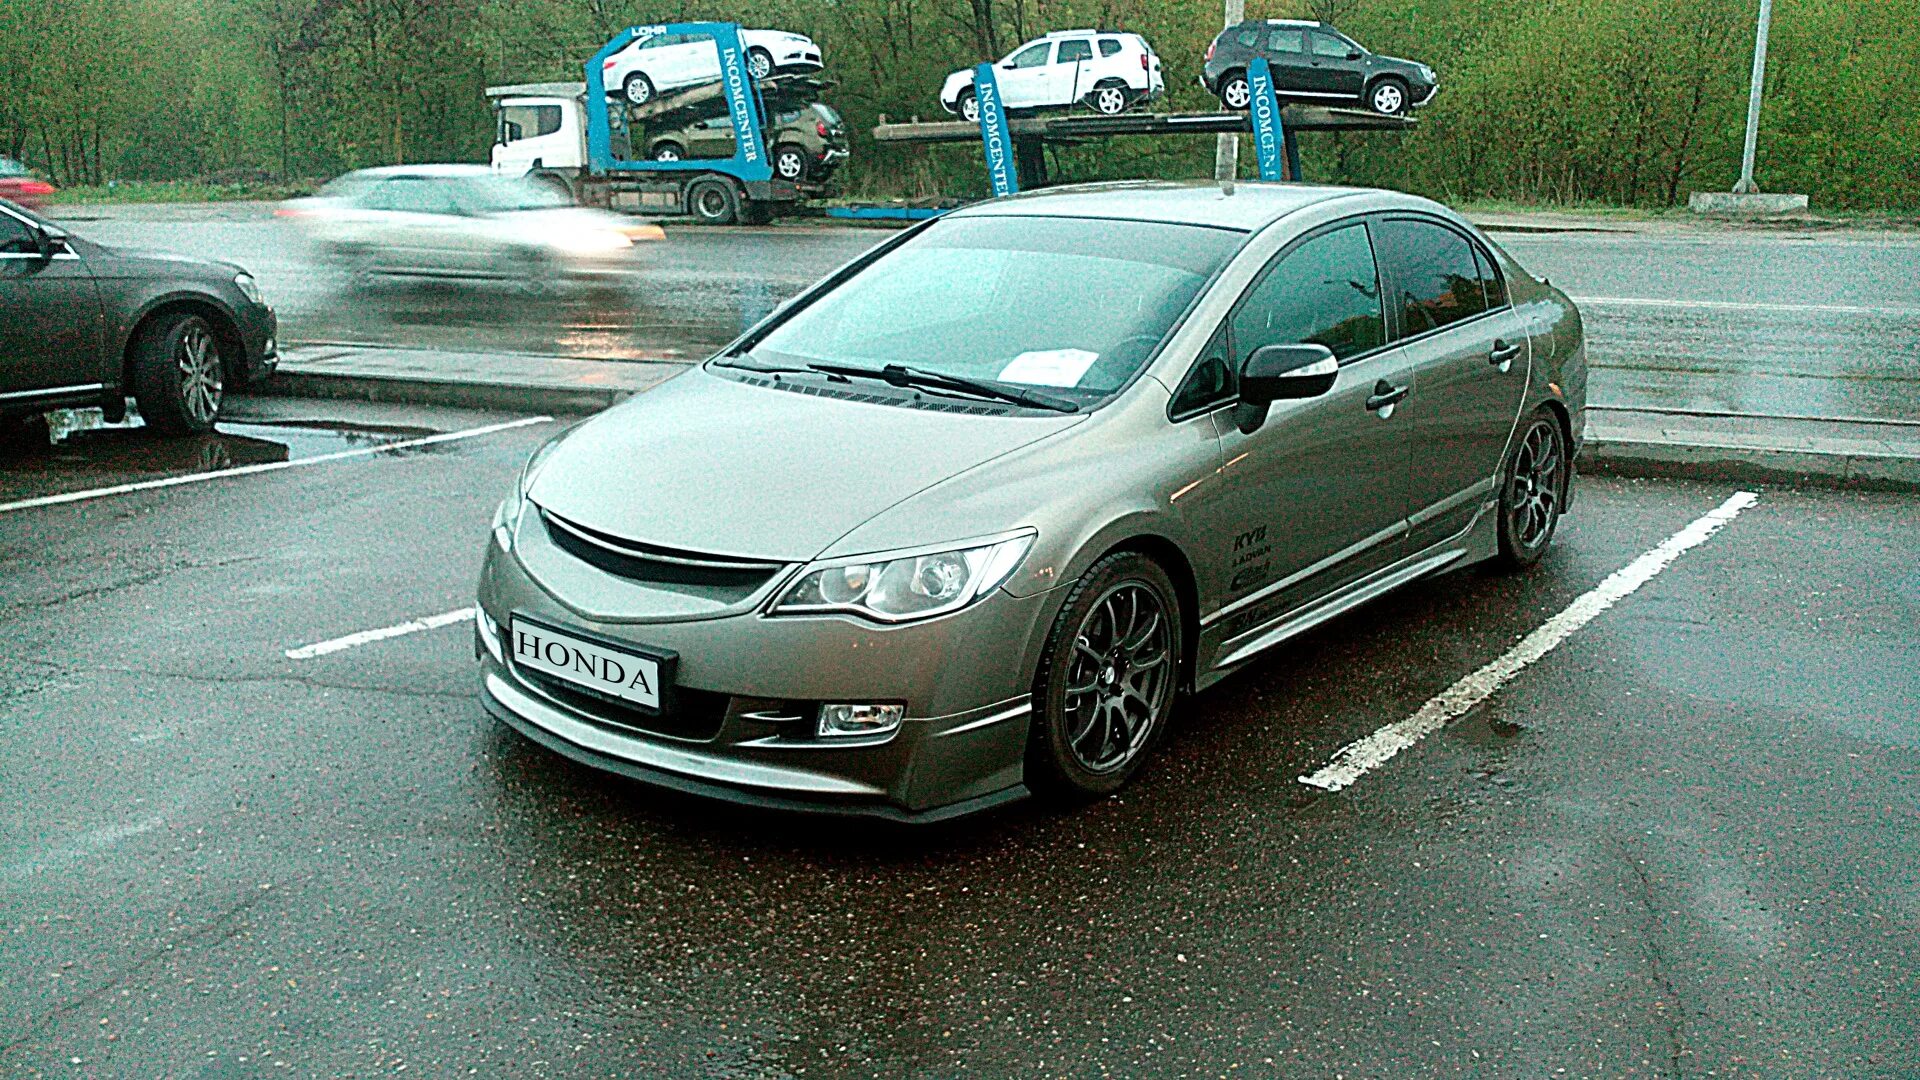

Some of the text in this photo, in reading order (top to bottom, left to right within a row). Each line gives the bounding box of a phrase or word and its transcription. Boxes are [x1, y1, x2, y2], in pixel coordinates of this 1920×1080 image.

[631, 25, 667, 36] LOHR
[724, 48, 757, 163] INCOMCENTER
[517, 631, 654, 695] HONDA
